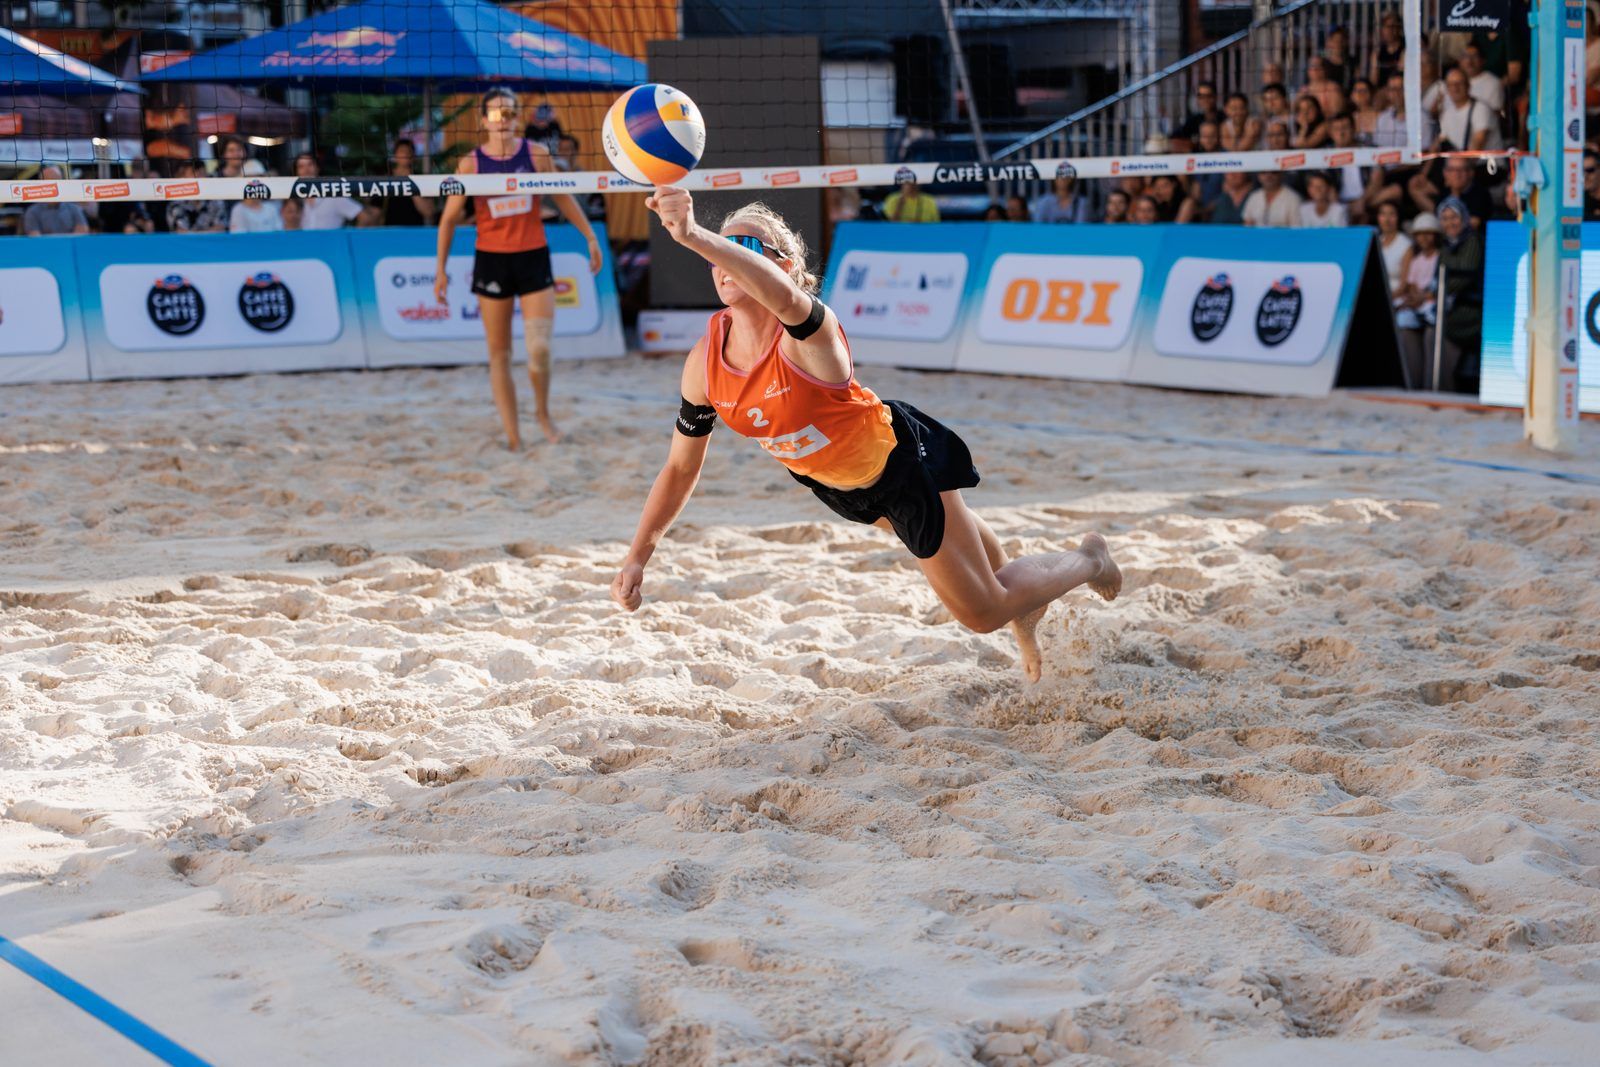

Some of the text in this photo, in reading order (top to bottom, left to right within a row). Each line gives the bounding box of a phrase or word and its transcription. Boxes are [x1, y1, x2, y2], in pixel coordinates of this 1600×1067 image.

[519, 179, 577, 188] edelweiss
[936, 163, 1034, 183] CAFFÈ LATTE
[295, 177, 413, 198] CAFFÈ LATTE
[1001, 278, 1120, 327] OBI
[747, 407, 770, 428] 2
